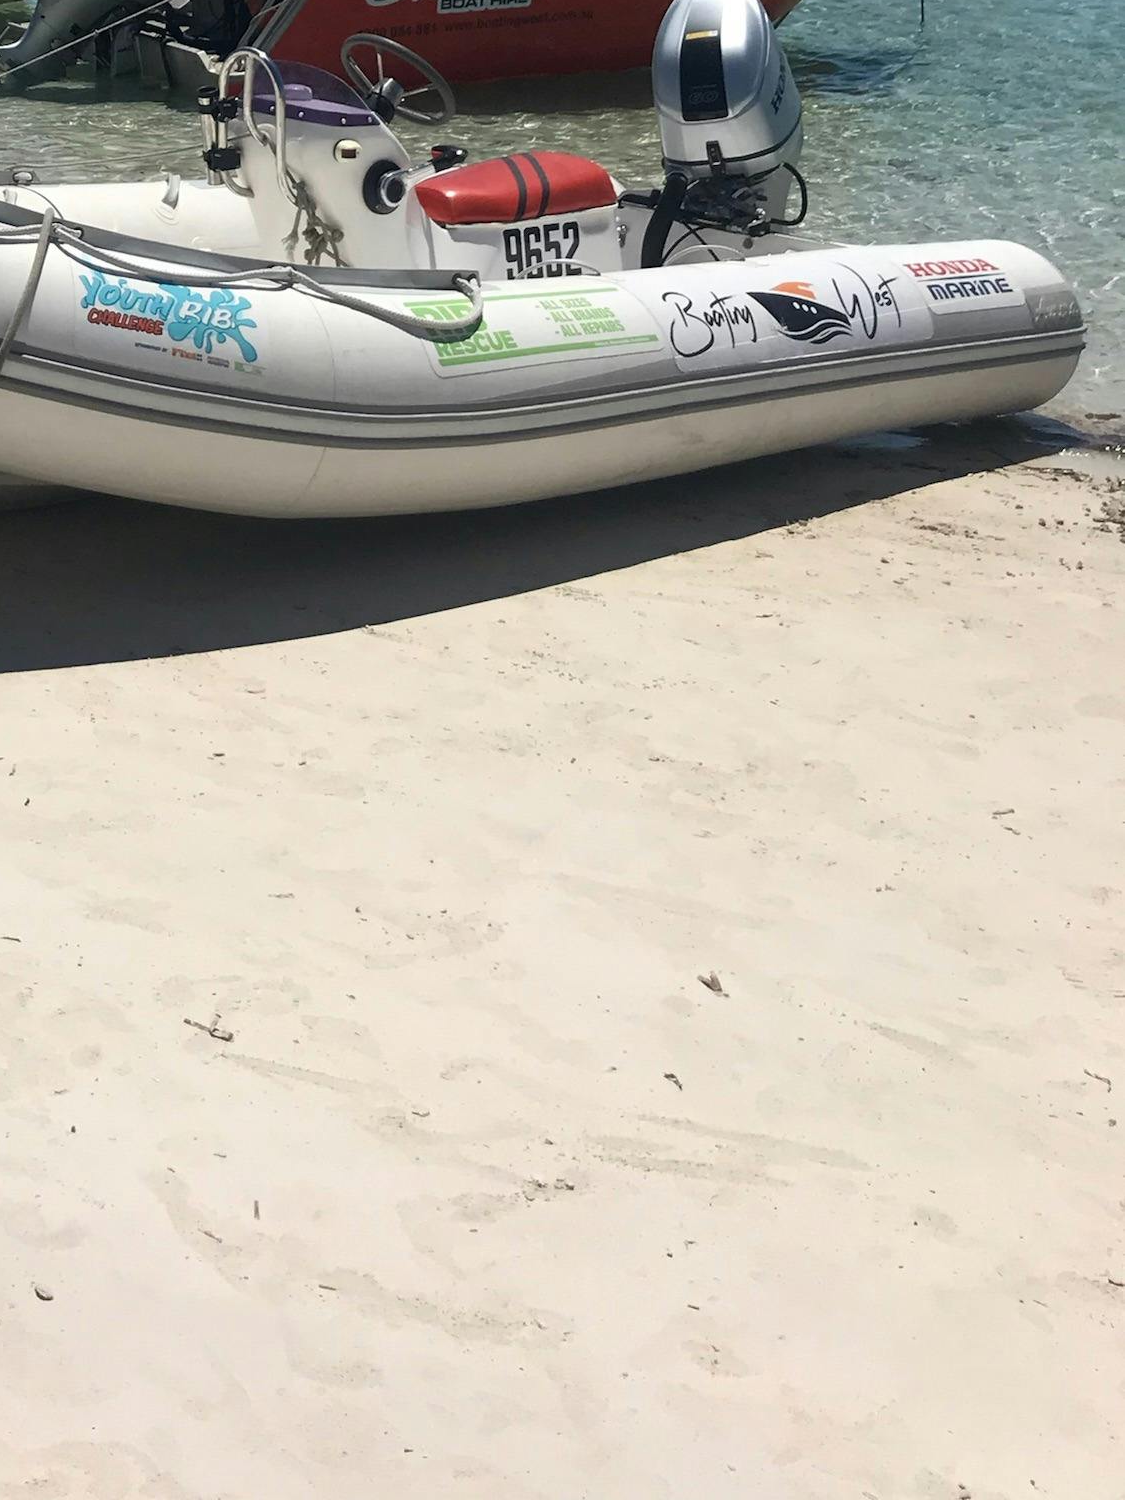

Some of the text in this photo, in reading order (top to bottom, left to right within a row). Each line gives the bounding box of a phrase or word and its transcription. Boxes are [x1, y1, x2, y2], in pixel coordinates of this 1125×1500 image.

[503, 221, 582, 280] 9652
[904, 258, 1000, 278] HONDA
[78, 273, 175, 322] YOUTH
[927, 278, 1013, 301] MARINE
[88, 308, 165, 336] CHALLENGE
[662, 263, 901, 358] Boating West
[434, 329, 519, 358] RESCUE
